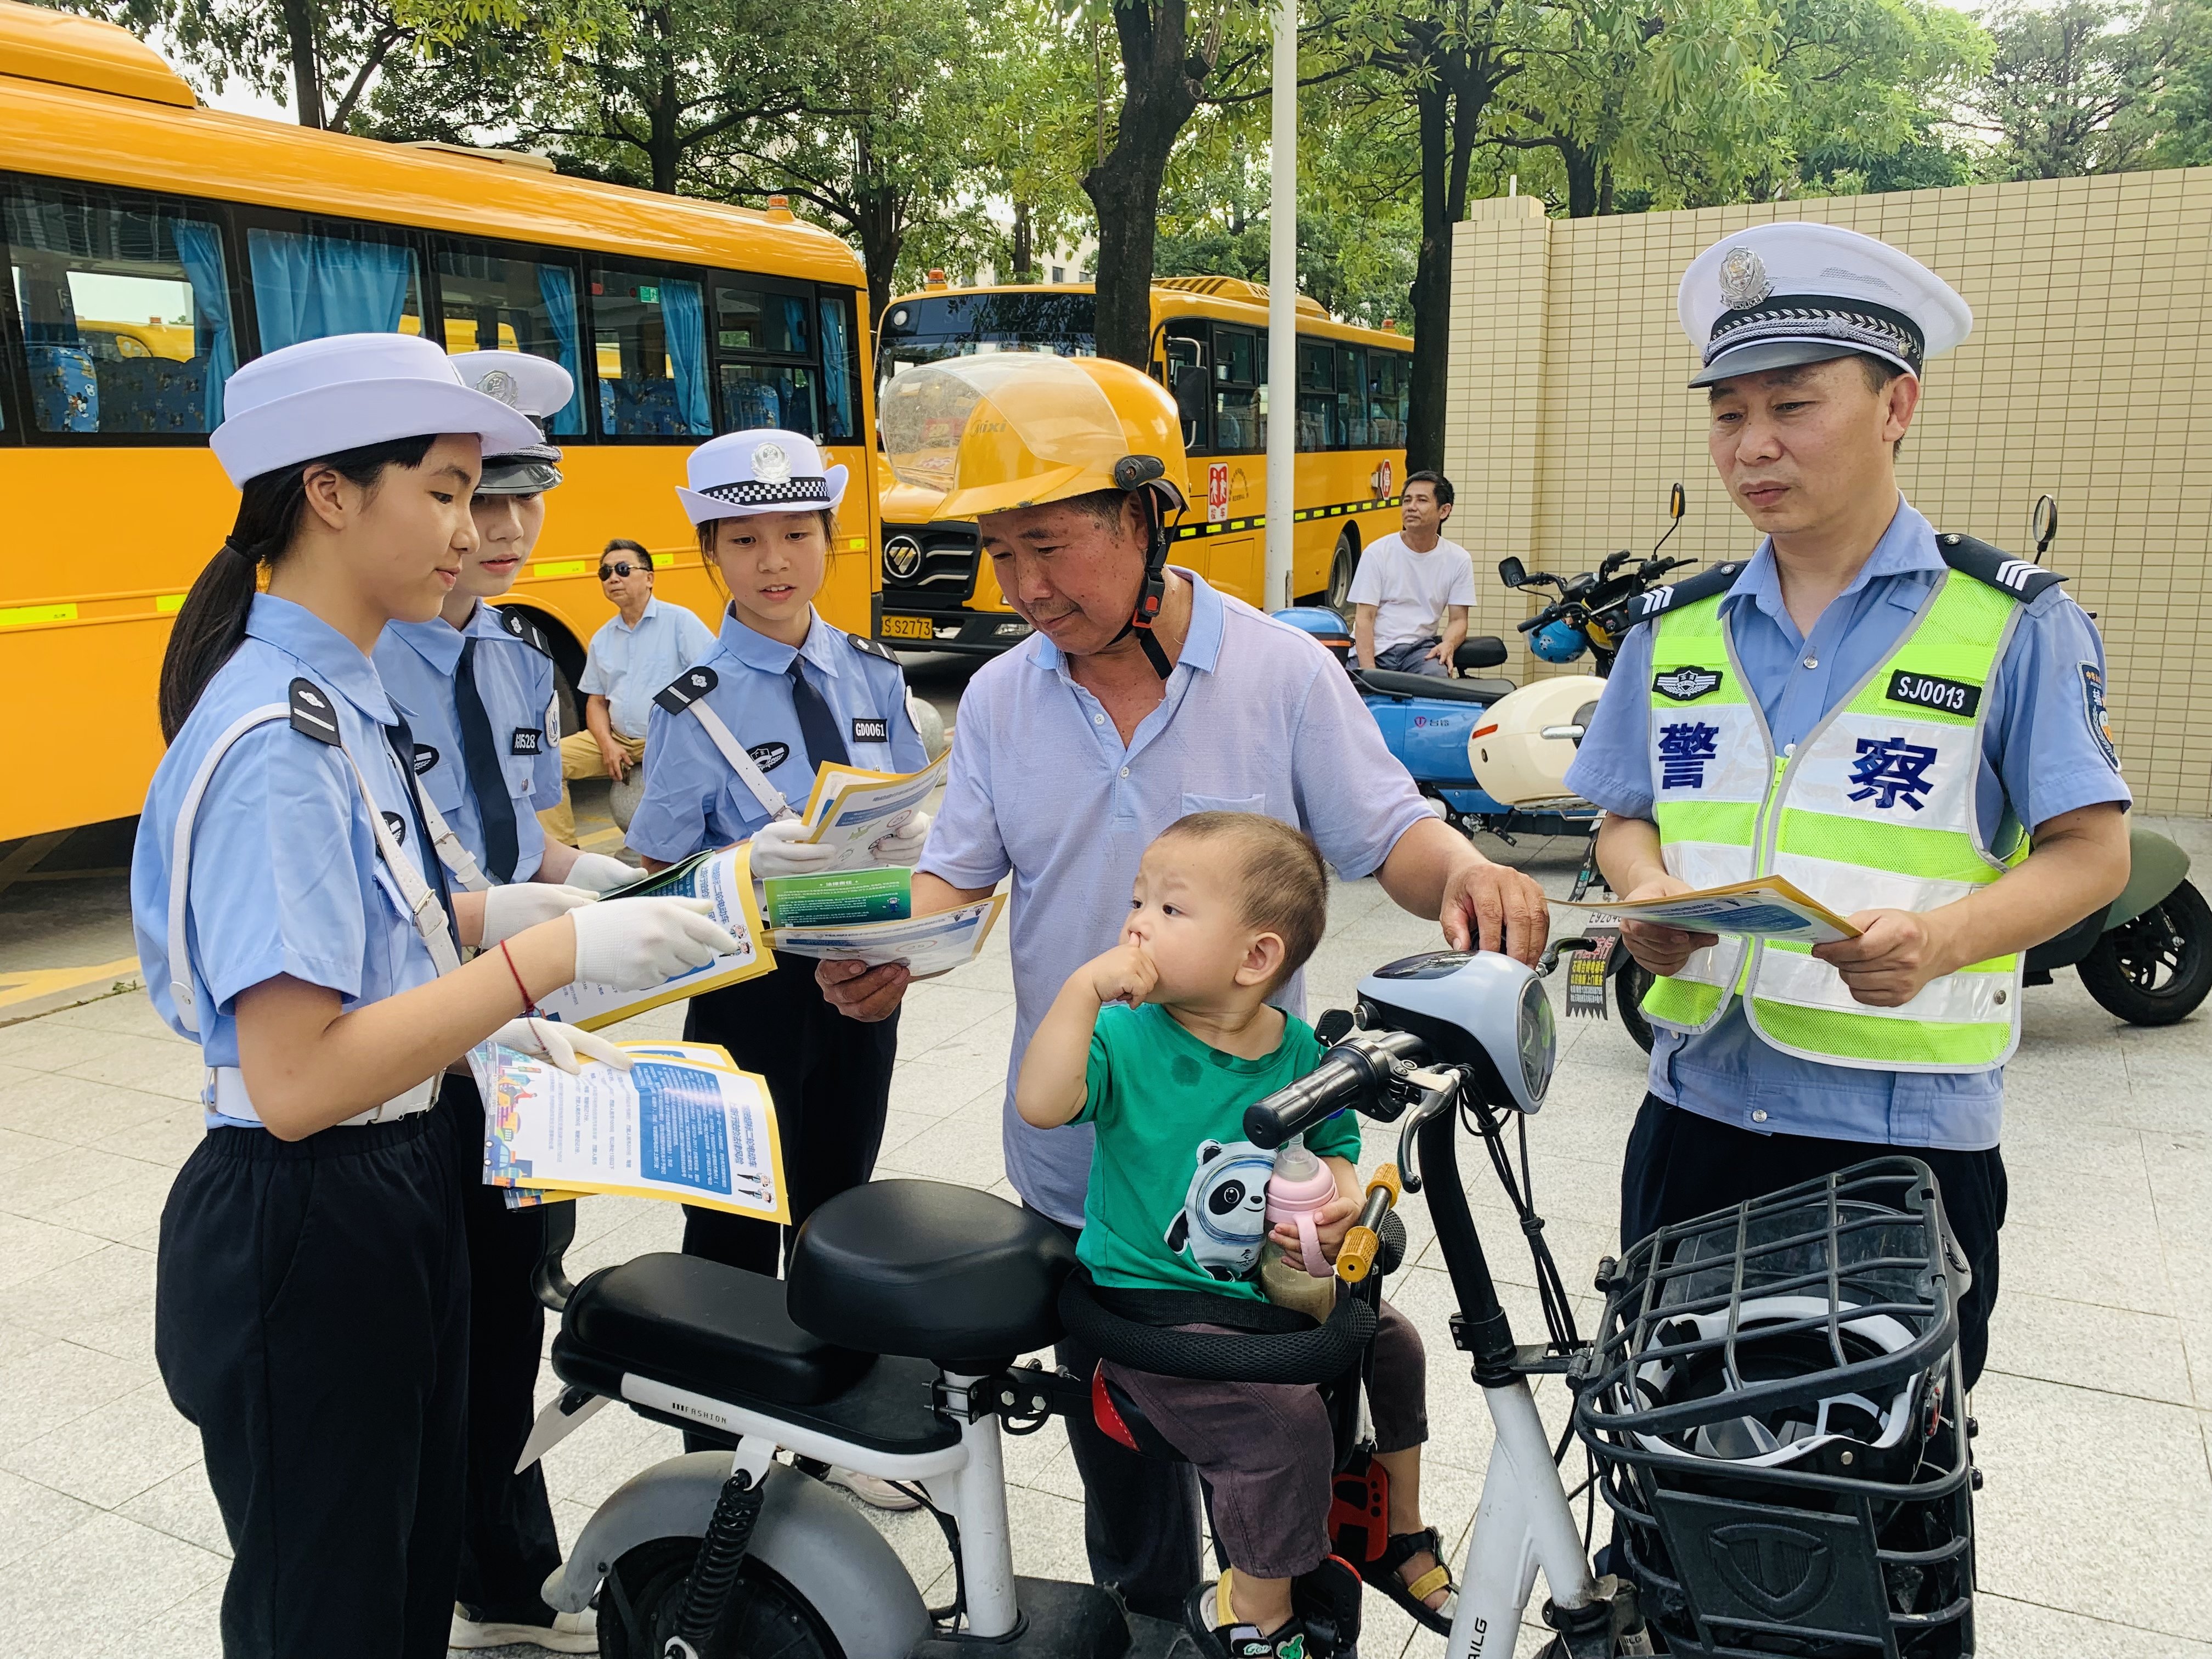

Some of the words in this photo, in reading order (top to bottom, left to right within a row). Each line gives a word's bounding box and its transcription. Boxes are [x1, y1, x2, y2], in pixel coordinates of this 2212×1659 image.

[1384, 467, 1390, 492] 停
[1898, 676, 1965, 709] SJ0013
[855, 723, 885, 737] GD0061
[1658, 721, 1719, 790] 警
[1847, 737, 1938, 812] 察
[685, 1406, 727, 1425] FASHION
